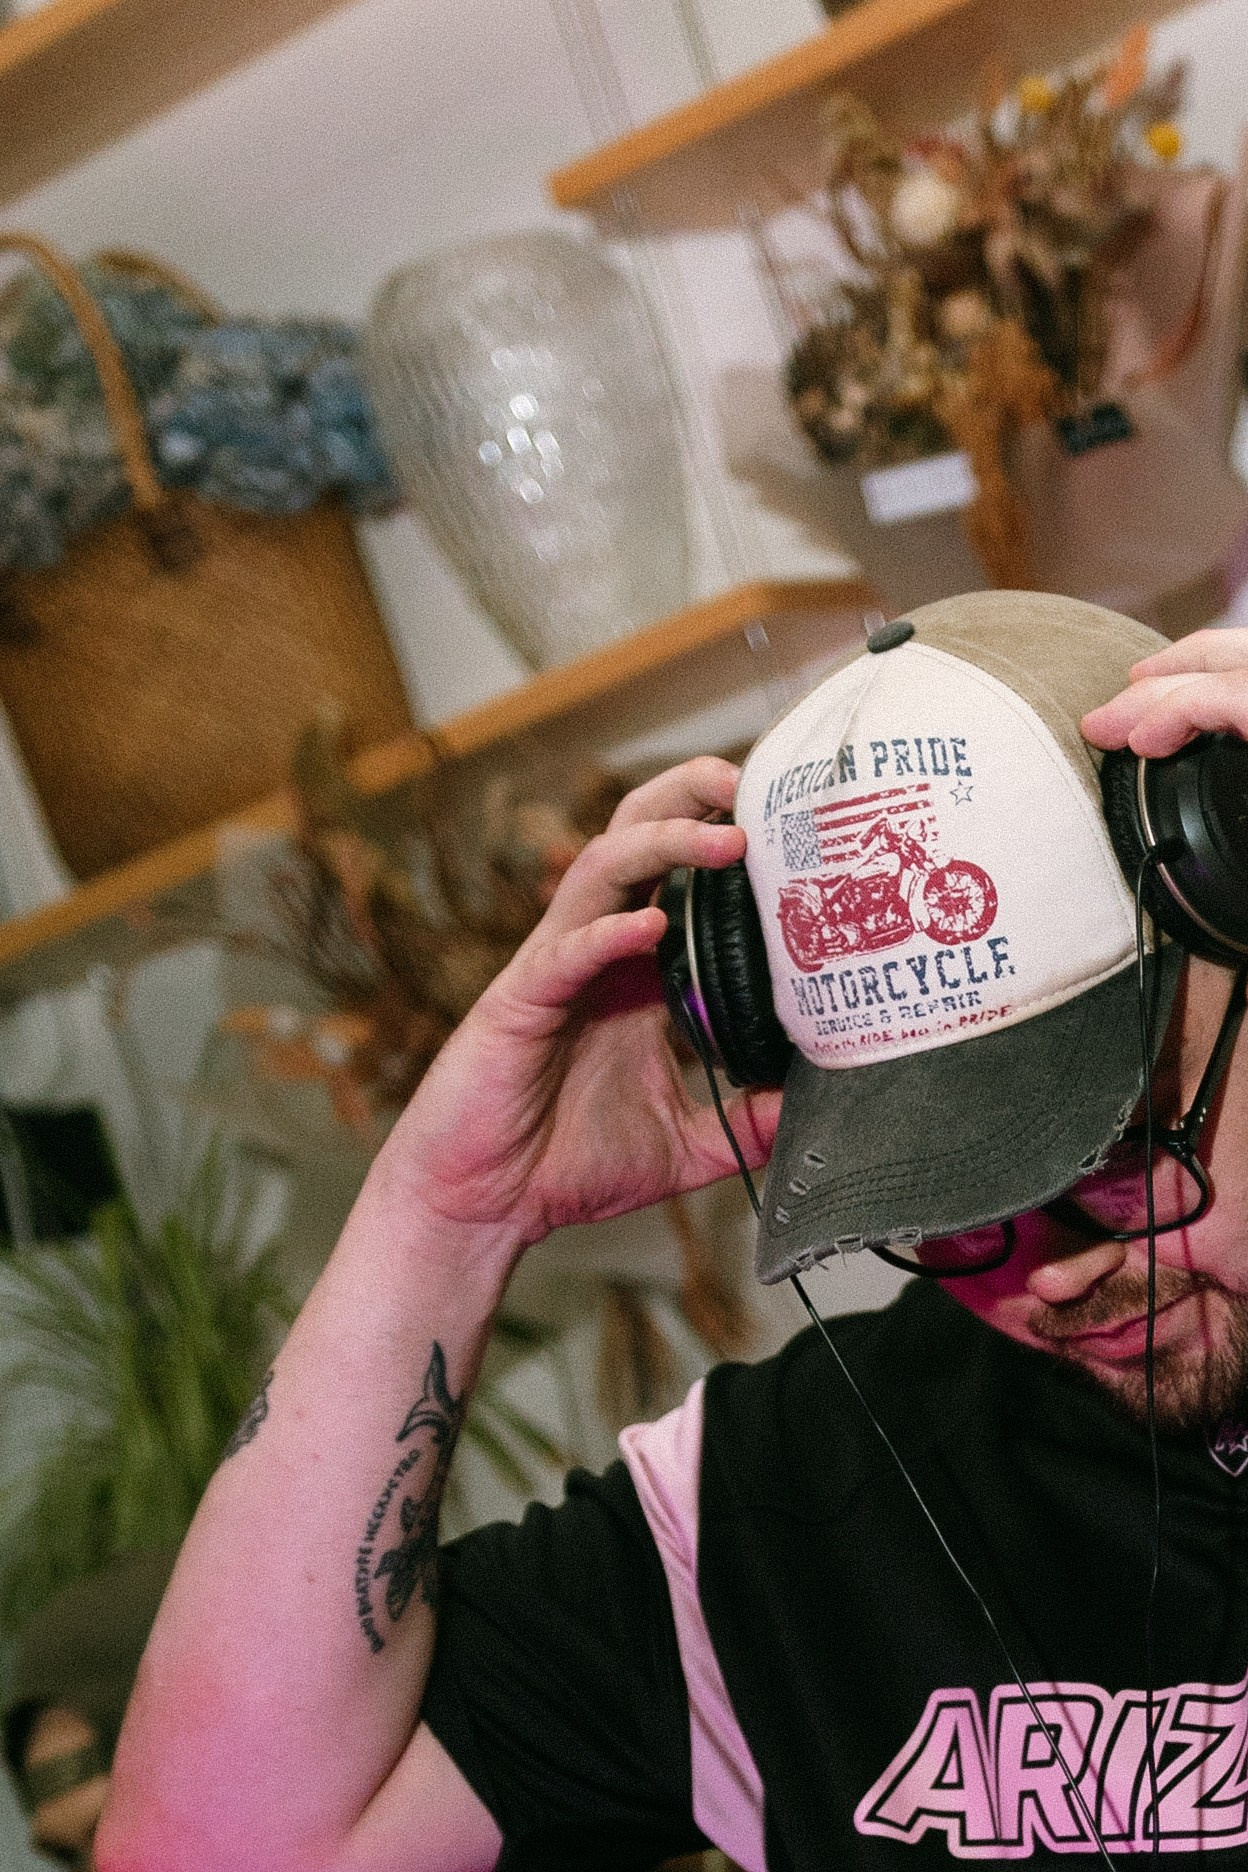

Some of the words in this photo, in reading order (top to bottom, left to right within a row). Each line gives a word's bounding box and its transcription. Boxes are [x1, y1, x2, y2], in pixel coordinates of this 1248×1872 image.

[764, 743, 856, 821] AMERICAN
[870, 736, 973, 779] PRIDE
[791, 936, 1016, 1017] MOTORCYCLE
[898, 990, 982, 1019] REPAIR
[860, 1030, 893, 1045] RIDE
